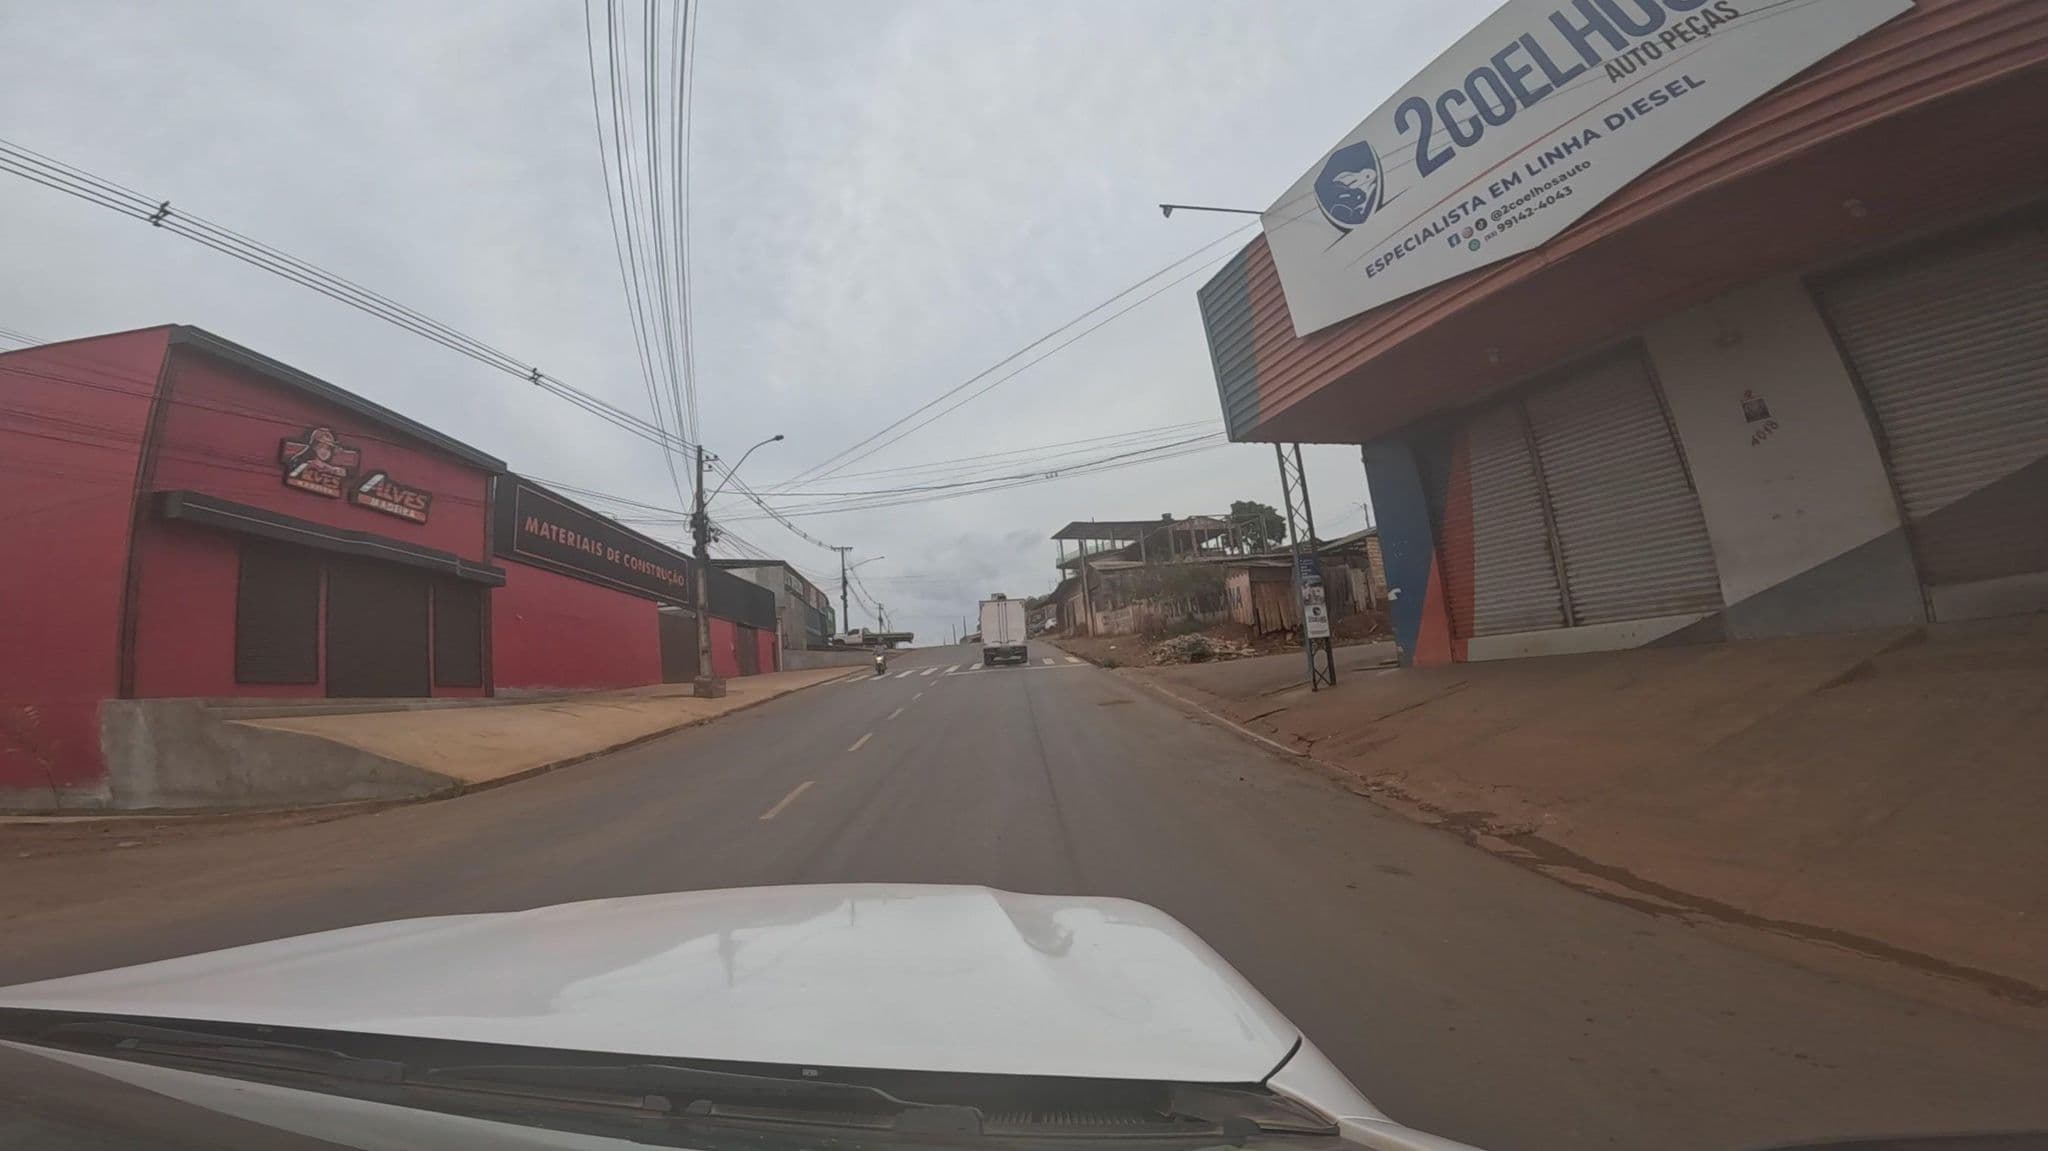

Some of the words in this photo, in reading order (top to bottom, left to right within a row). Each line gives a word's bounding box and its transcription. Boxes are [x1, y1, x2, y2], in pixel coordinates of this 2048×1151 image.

[1604, 41, 1662, 83] AUTO
[1658, 1, 1739, 50] PEÇAS
[1394, 0, 1708, 177] 2COELHO
[1365, 195, 1487, 279] ESPECIALISTA
[1488, 171, 1522, 199] EM
[1525, 128, 1601, 177] LINHA
[1603, 74, 1706, 131] DIESEL
[1490, 160, 1592, 222] @2coelhosauto
[1497, 185, 1573, 233] 99142-4043
[360, 474, 427, 510] ALVES
[370, 497, 417, 519] MADEIRA
[525, 516, 603, 556] MATERIAIS
[606, 547, 621, 563] DE
[623, 554, 685, 587] CONSTRUÇÃO
